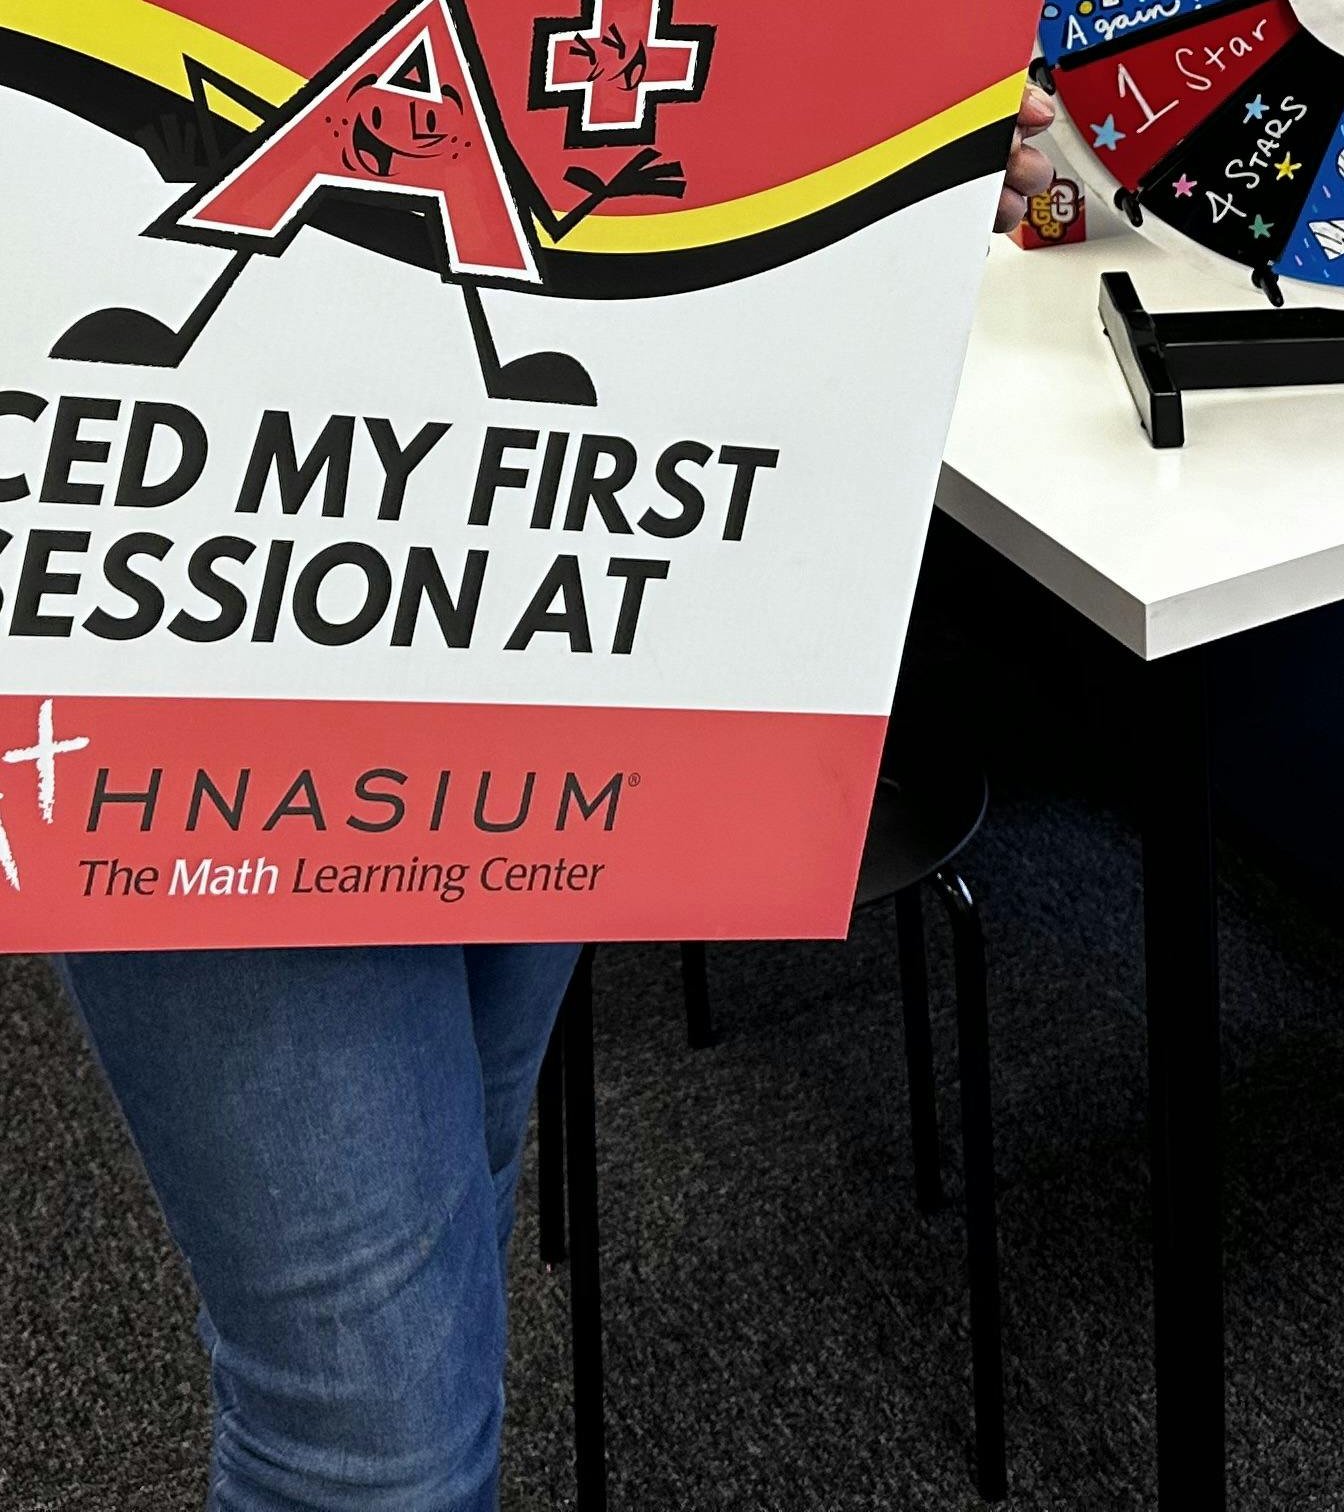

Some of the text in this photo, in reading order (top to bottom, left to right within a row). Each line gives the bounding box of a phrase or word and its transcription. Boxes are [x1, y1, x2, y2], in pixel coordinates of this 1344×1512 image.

[1117, 19, 1267, 134] 1 Star
[1205, 189, 1247, 223] 4
[234, 409, 453, 522] MY
[467, 426, 779, 542] FIRST
[503, 553, 671, 655] AT
[78, 856, 606, 904] The Math Learning Center
